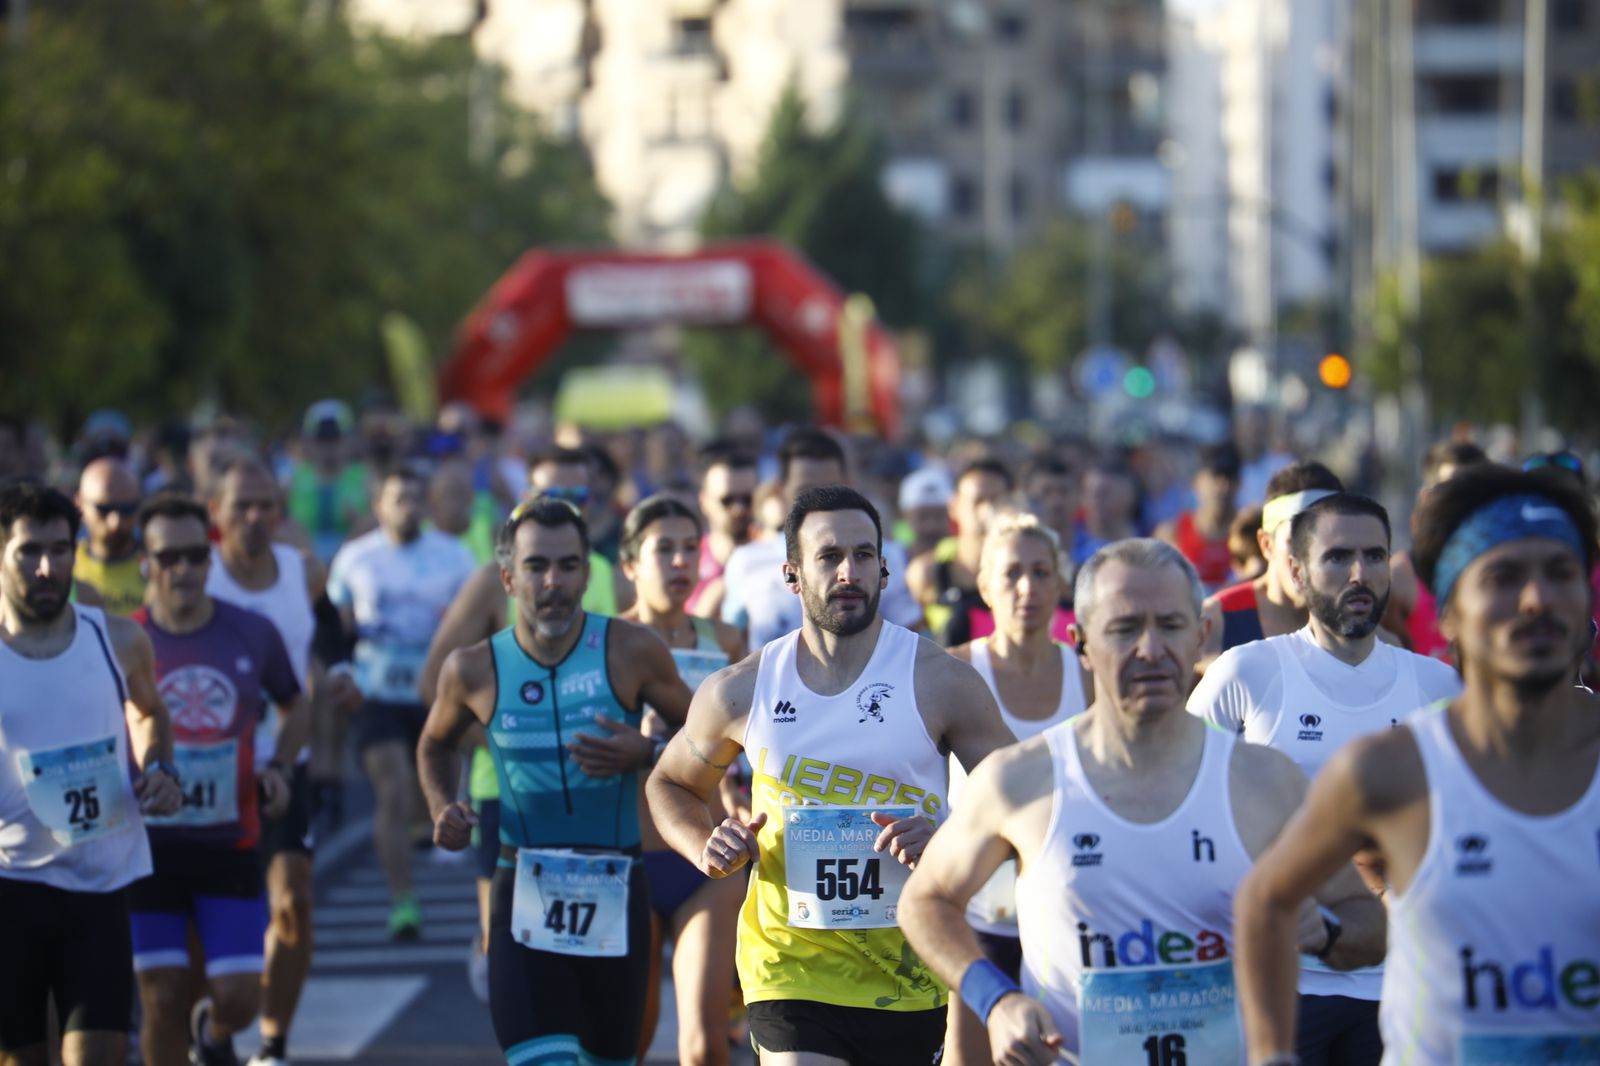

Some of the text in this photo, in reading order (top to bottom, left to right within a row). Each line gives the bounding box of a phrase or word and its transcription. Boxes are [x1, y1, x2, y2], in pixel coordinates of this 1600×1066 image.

[63, 785, 100, 824] 25
[181, 778, 218, 809] 41
[790, 829, 836, 842] MEDIA
[1191, 829, 1216, 863] in
[815, 858, 885, 901] 554
[544, 899, 598, 937] 417
[1077, 918, 1229, 969] indea
[1085, 993, 1144, 1014] MEDIA
[1142, 1033, 1188, 1066] 16
